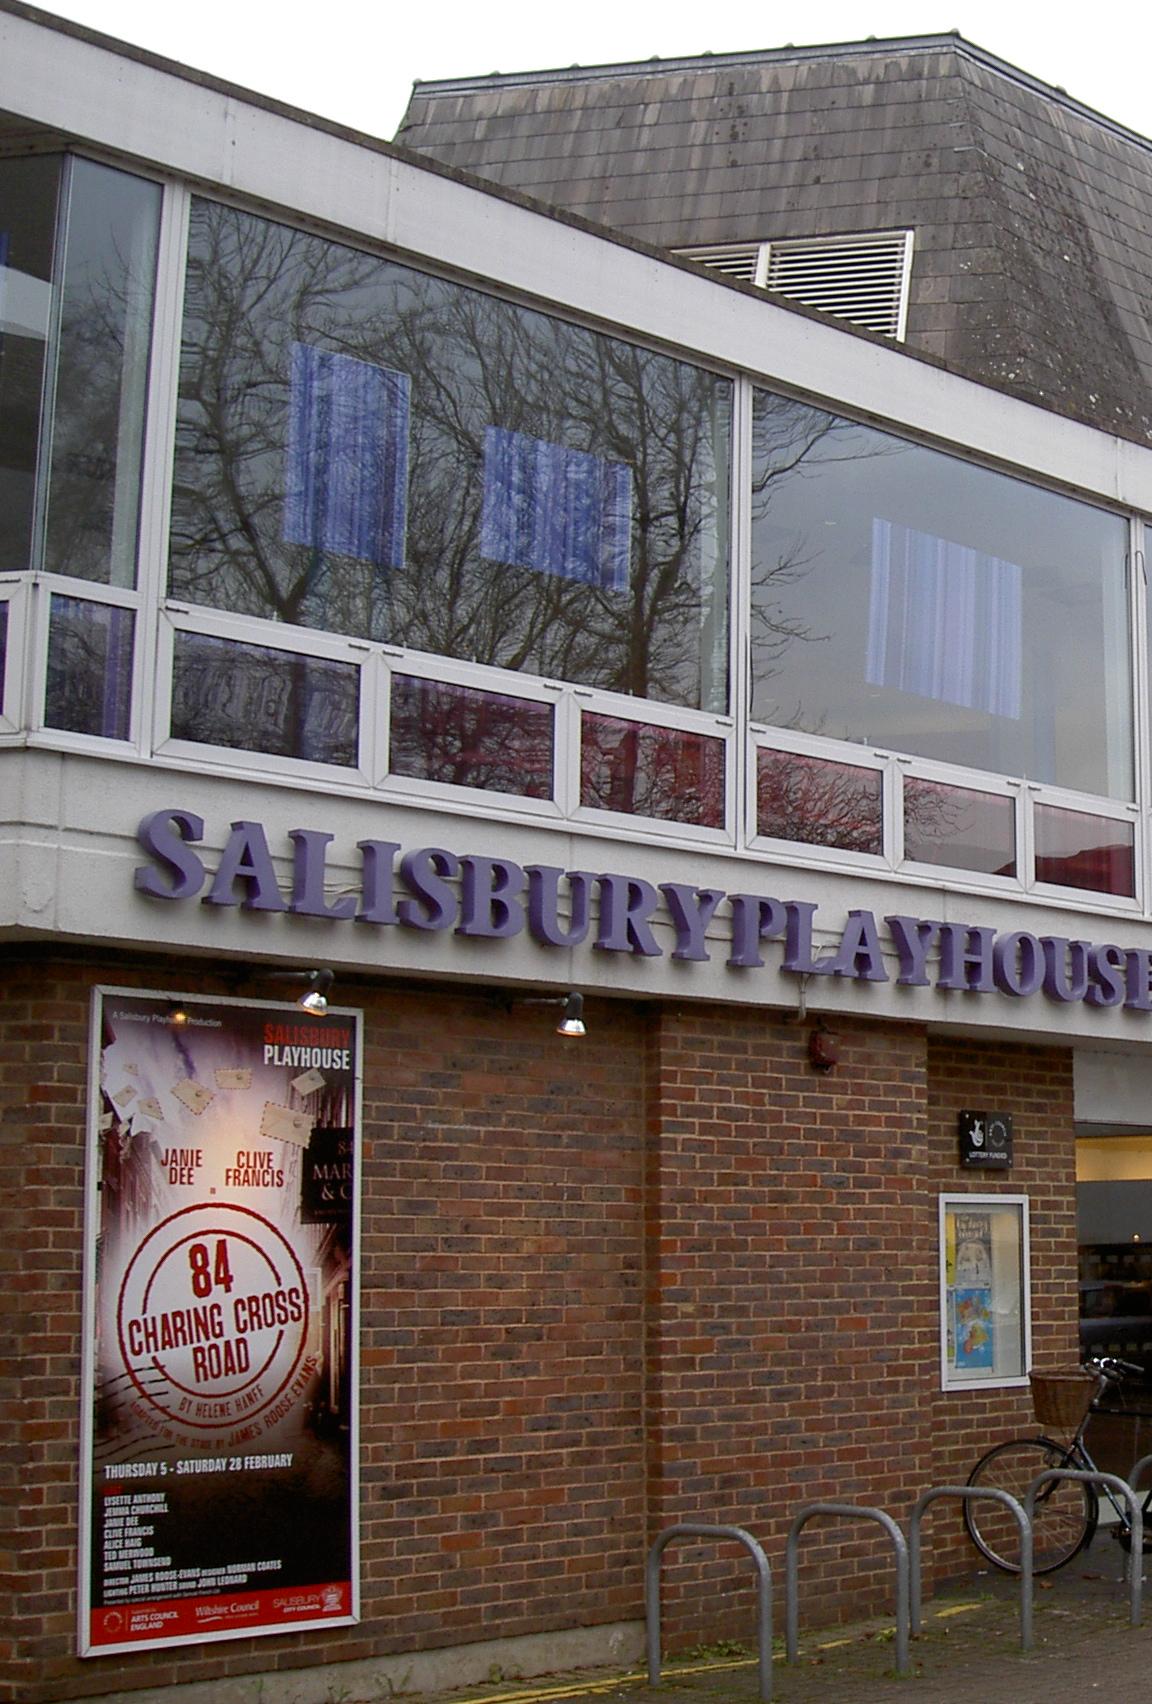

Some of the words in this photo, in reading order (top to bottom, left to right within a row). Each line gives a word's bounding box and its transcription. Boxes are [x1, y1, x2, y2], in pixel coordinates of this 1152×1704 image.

[264, 1024, 349, 1048] SALISBURY
[264, 1045, 350, 1069] PLAYHOUSE
[161, 1149, 202, 1167] JANIE
[236, 1151, 274, 1169] CLIVE
[169, 1168, 194, 1185] DEE
[225, 1169, 284, 1188] FRANCIS
[189, 1239, 233, 1298] 84
[128, 1303, 224, 1356] CHARING
[234, 1287, 302, 1334] CROSS
[192, 1337, 250, 1383] ROAD
[178, 1396, 192, 1413] BY
[195, 1401, 232, 1419] HELENE
[235, 1383, 264, 1413] HANFF
[229, 1424, 263, 1447] JAMES
[104, 1464, 158, 1479] THURSDAY
[160, 1462, 168, 1475] 5
[176, 1458, 227, 1474] SATURDAY
[229, 1456, 242, 1471] 28
[244, 1453, 294, 1470] FEBRUARY
[230, 1600, 260, 1614] Council
[273, 1595, 322, 1609] SALISBURY
[131, 1613, 149, 1623] ARTS
[150, 1611, 179, 1622] COUNCIL
[131, 1621, 164, 1632] ENGLAND
